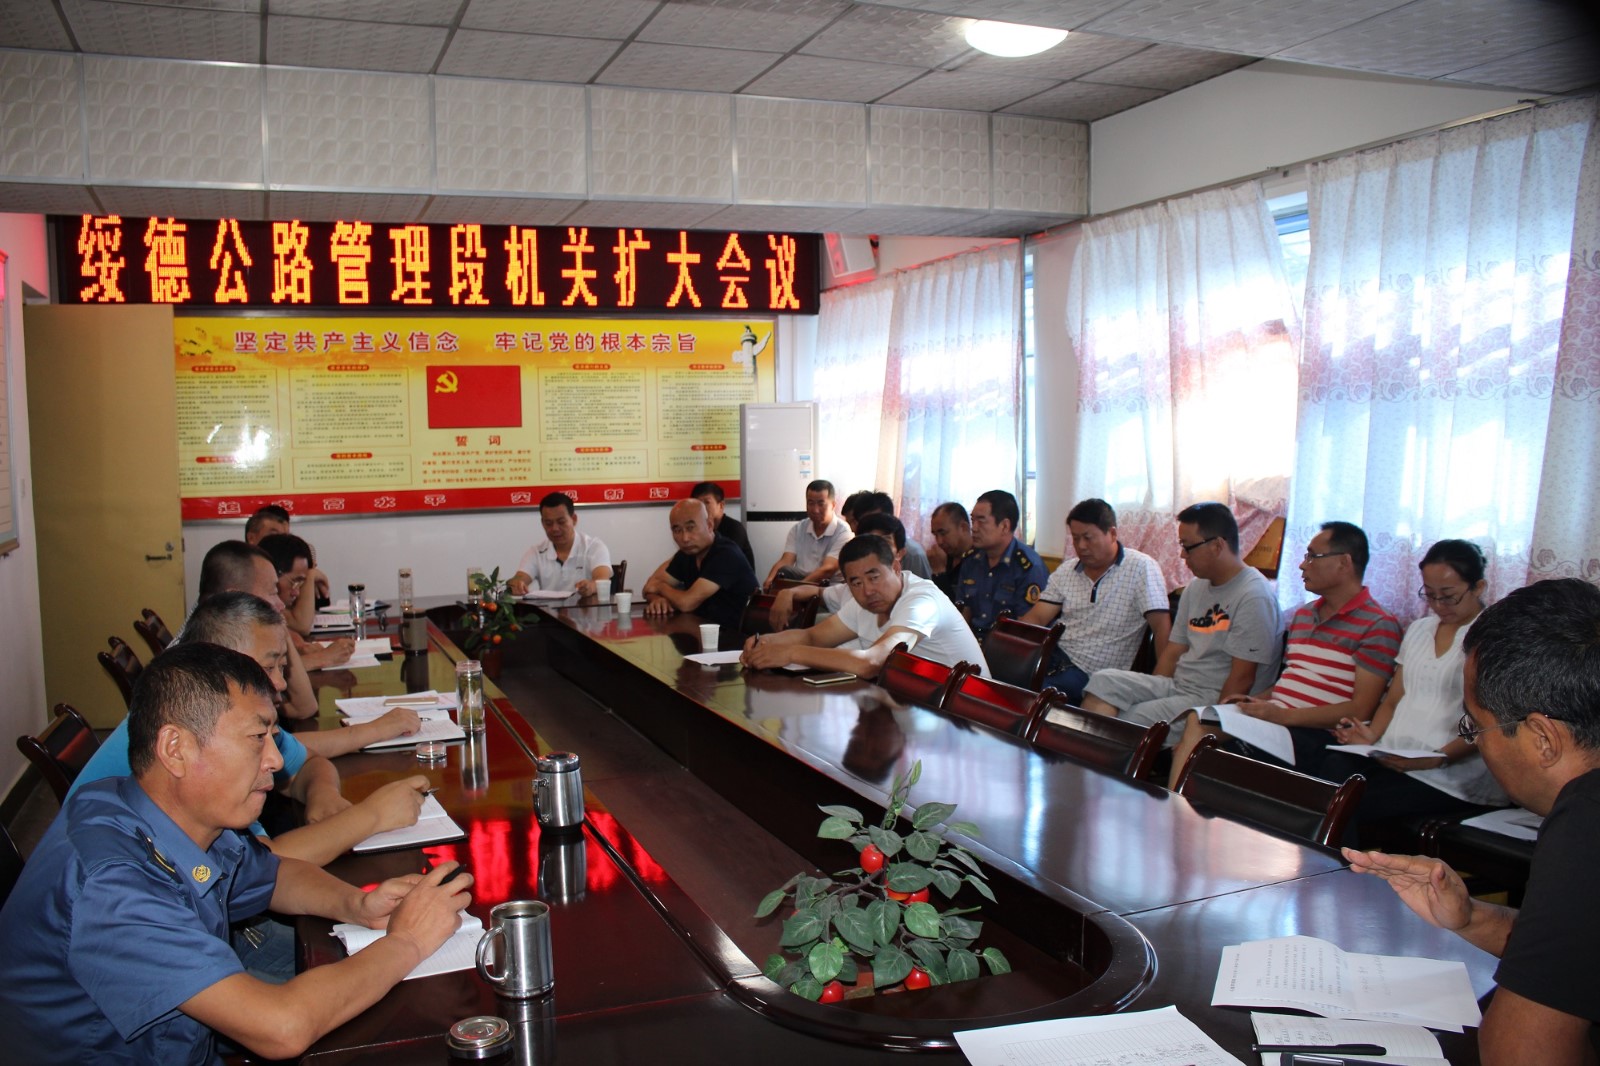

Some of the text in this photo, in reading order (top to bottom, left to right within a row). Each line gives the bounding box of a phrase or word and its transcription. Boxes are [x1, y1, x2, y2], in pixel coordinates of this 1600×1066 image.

[78, 213, 801, 310] 绥德公路管理段机关扩大会议
[234, 331, 460, 353] 坚定共产主义信念
[495, 331, 698, 353] 牢记党的根本宗旨
[455, 435, 501, 447] 誓词
